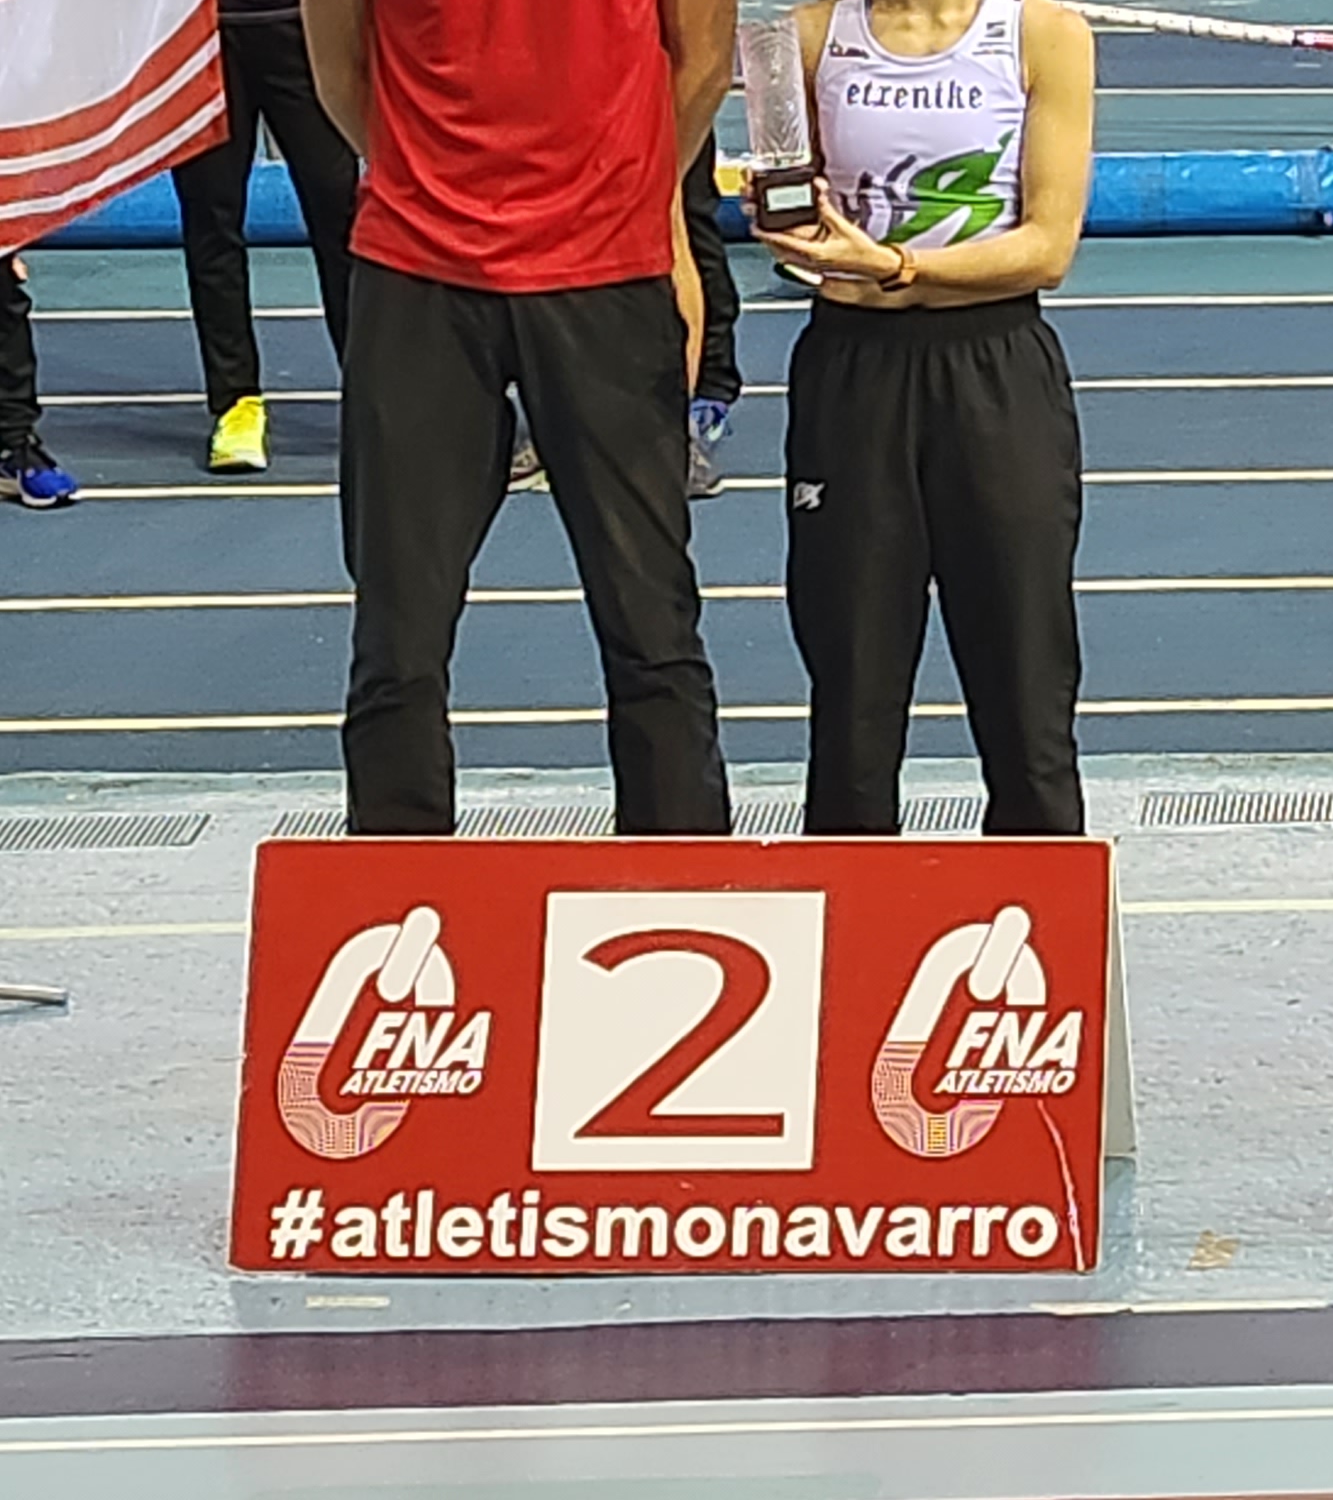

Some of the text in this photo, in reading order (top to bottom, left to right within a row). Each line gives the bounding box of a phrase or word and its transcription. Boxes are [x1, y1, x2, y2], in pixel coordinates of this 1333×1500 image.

[352, 1011, 492, 1069] FNA
[572, 928, 785, 1139] 2
[945, 1011, 1083, 1069] FNA
[338, 1070, 483, 1096] ATLETISMO
[932, 1070, 1076, 1095] ATLETISMO
[270, 1188, 1058, 1258] #atletismonavarro
